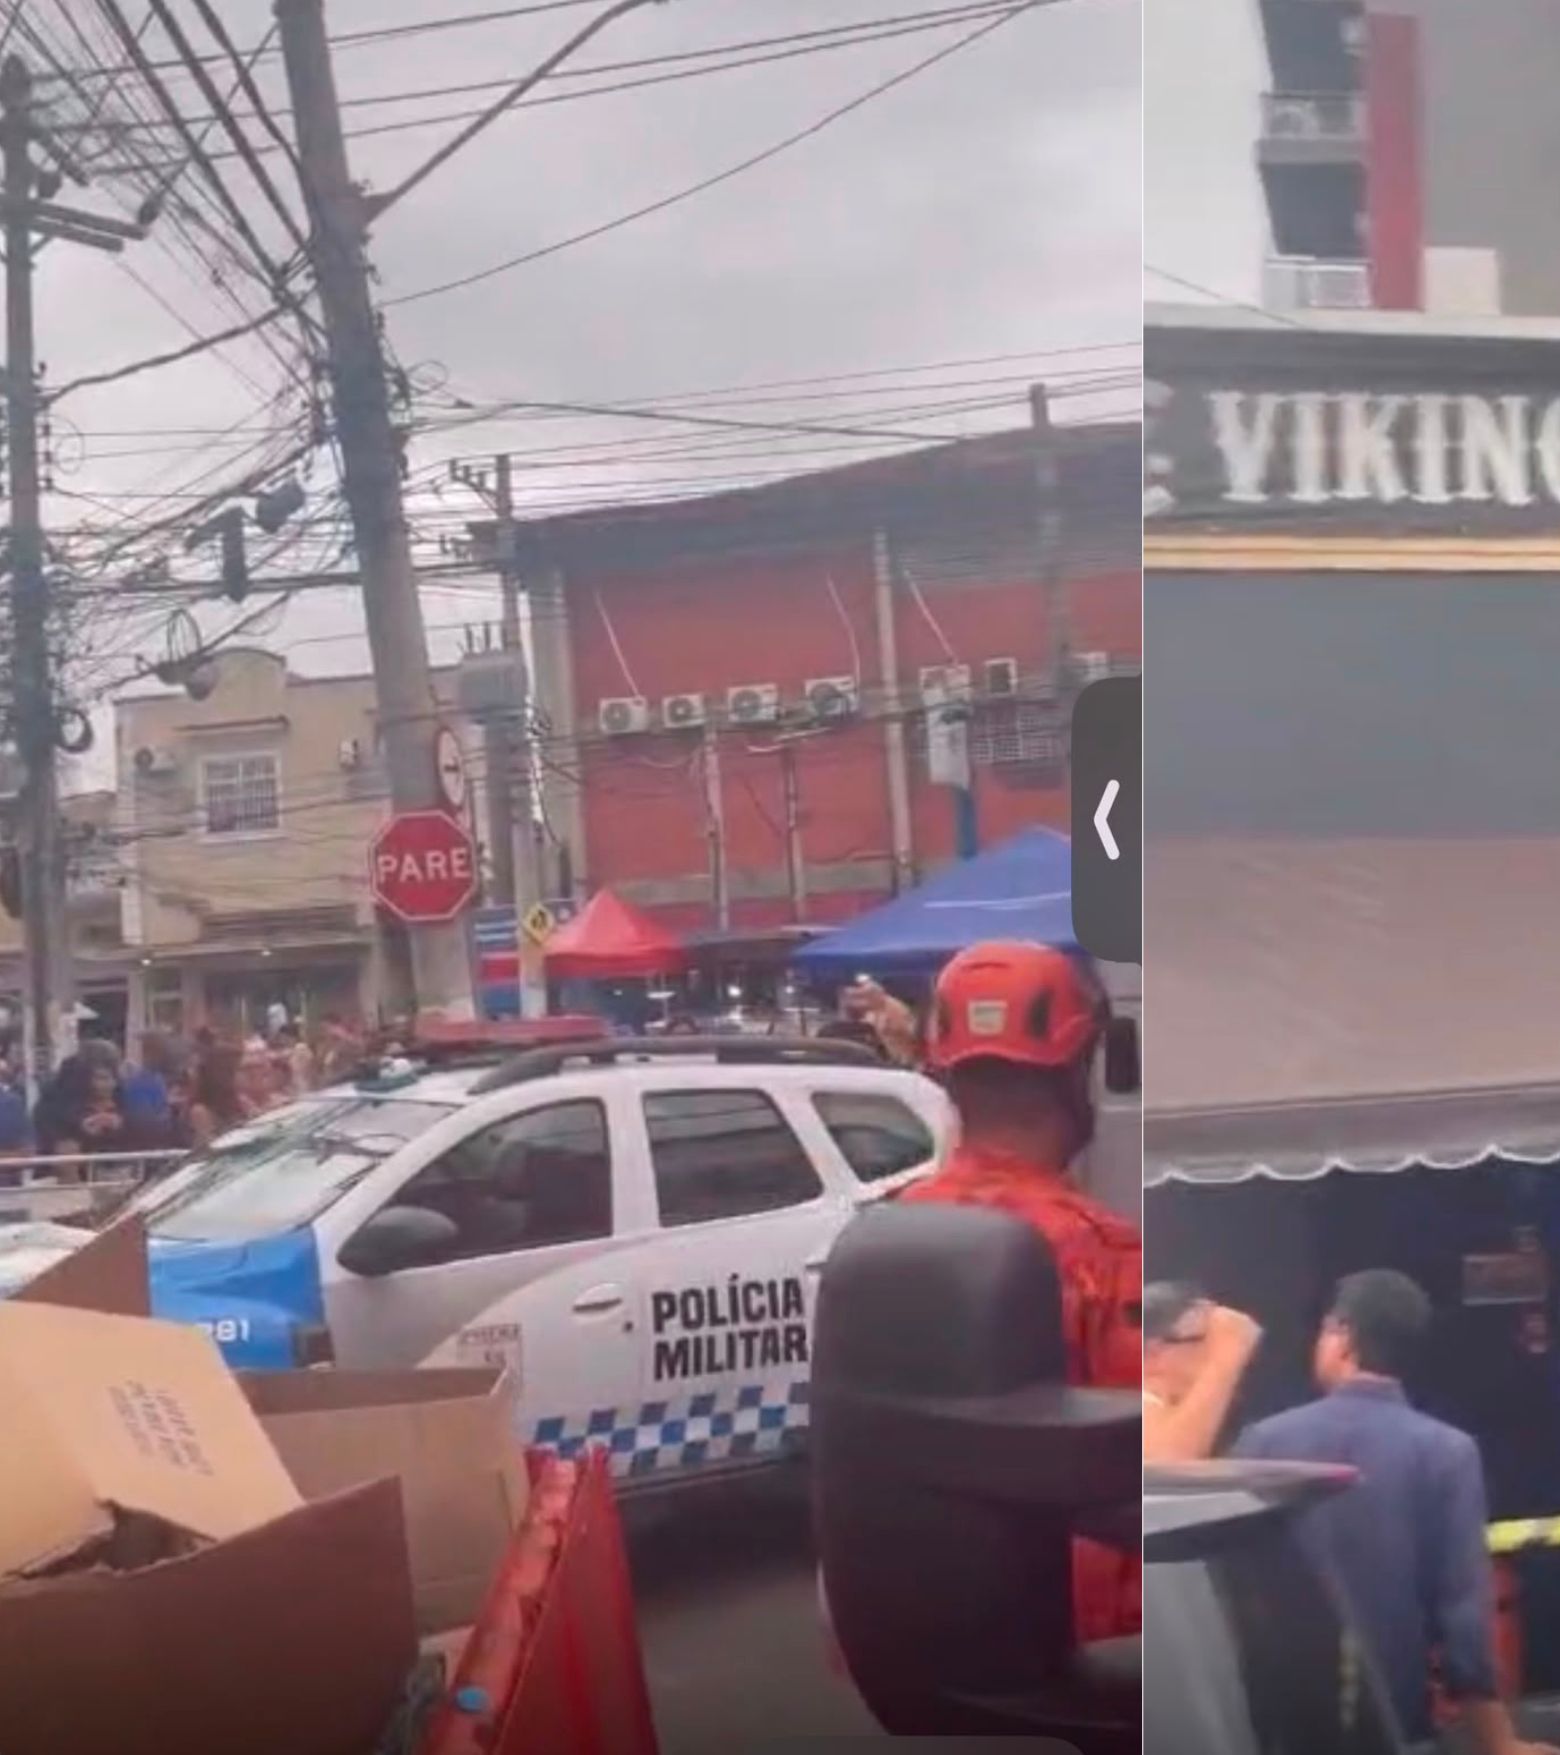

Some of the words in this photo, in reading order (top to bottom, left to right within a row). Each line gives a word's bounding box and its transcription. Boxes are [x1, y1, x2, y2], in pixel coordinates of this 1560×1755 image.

[378, 847, 471, 883] PARE
[651, 1272, 804, 1334] POLÍCIA
[654, 1322, 808, 1381] MILITAR
